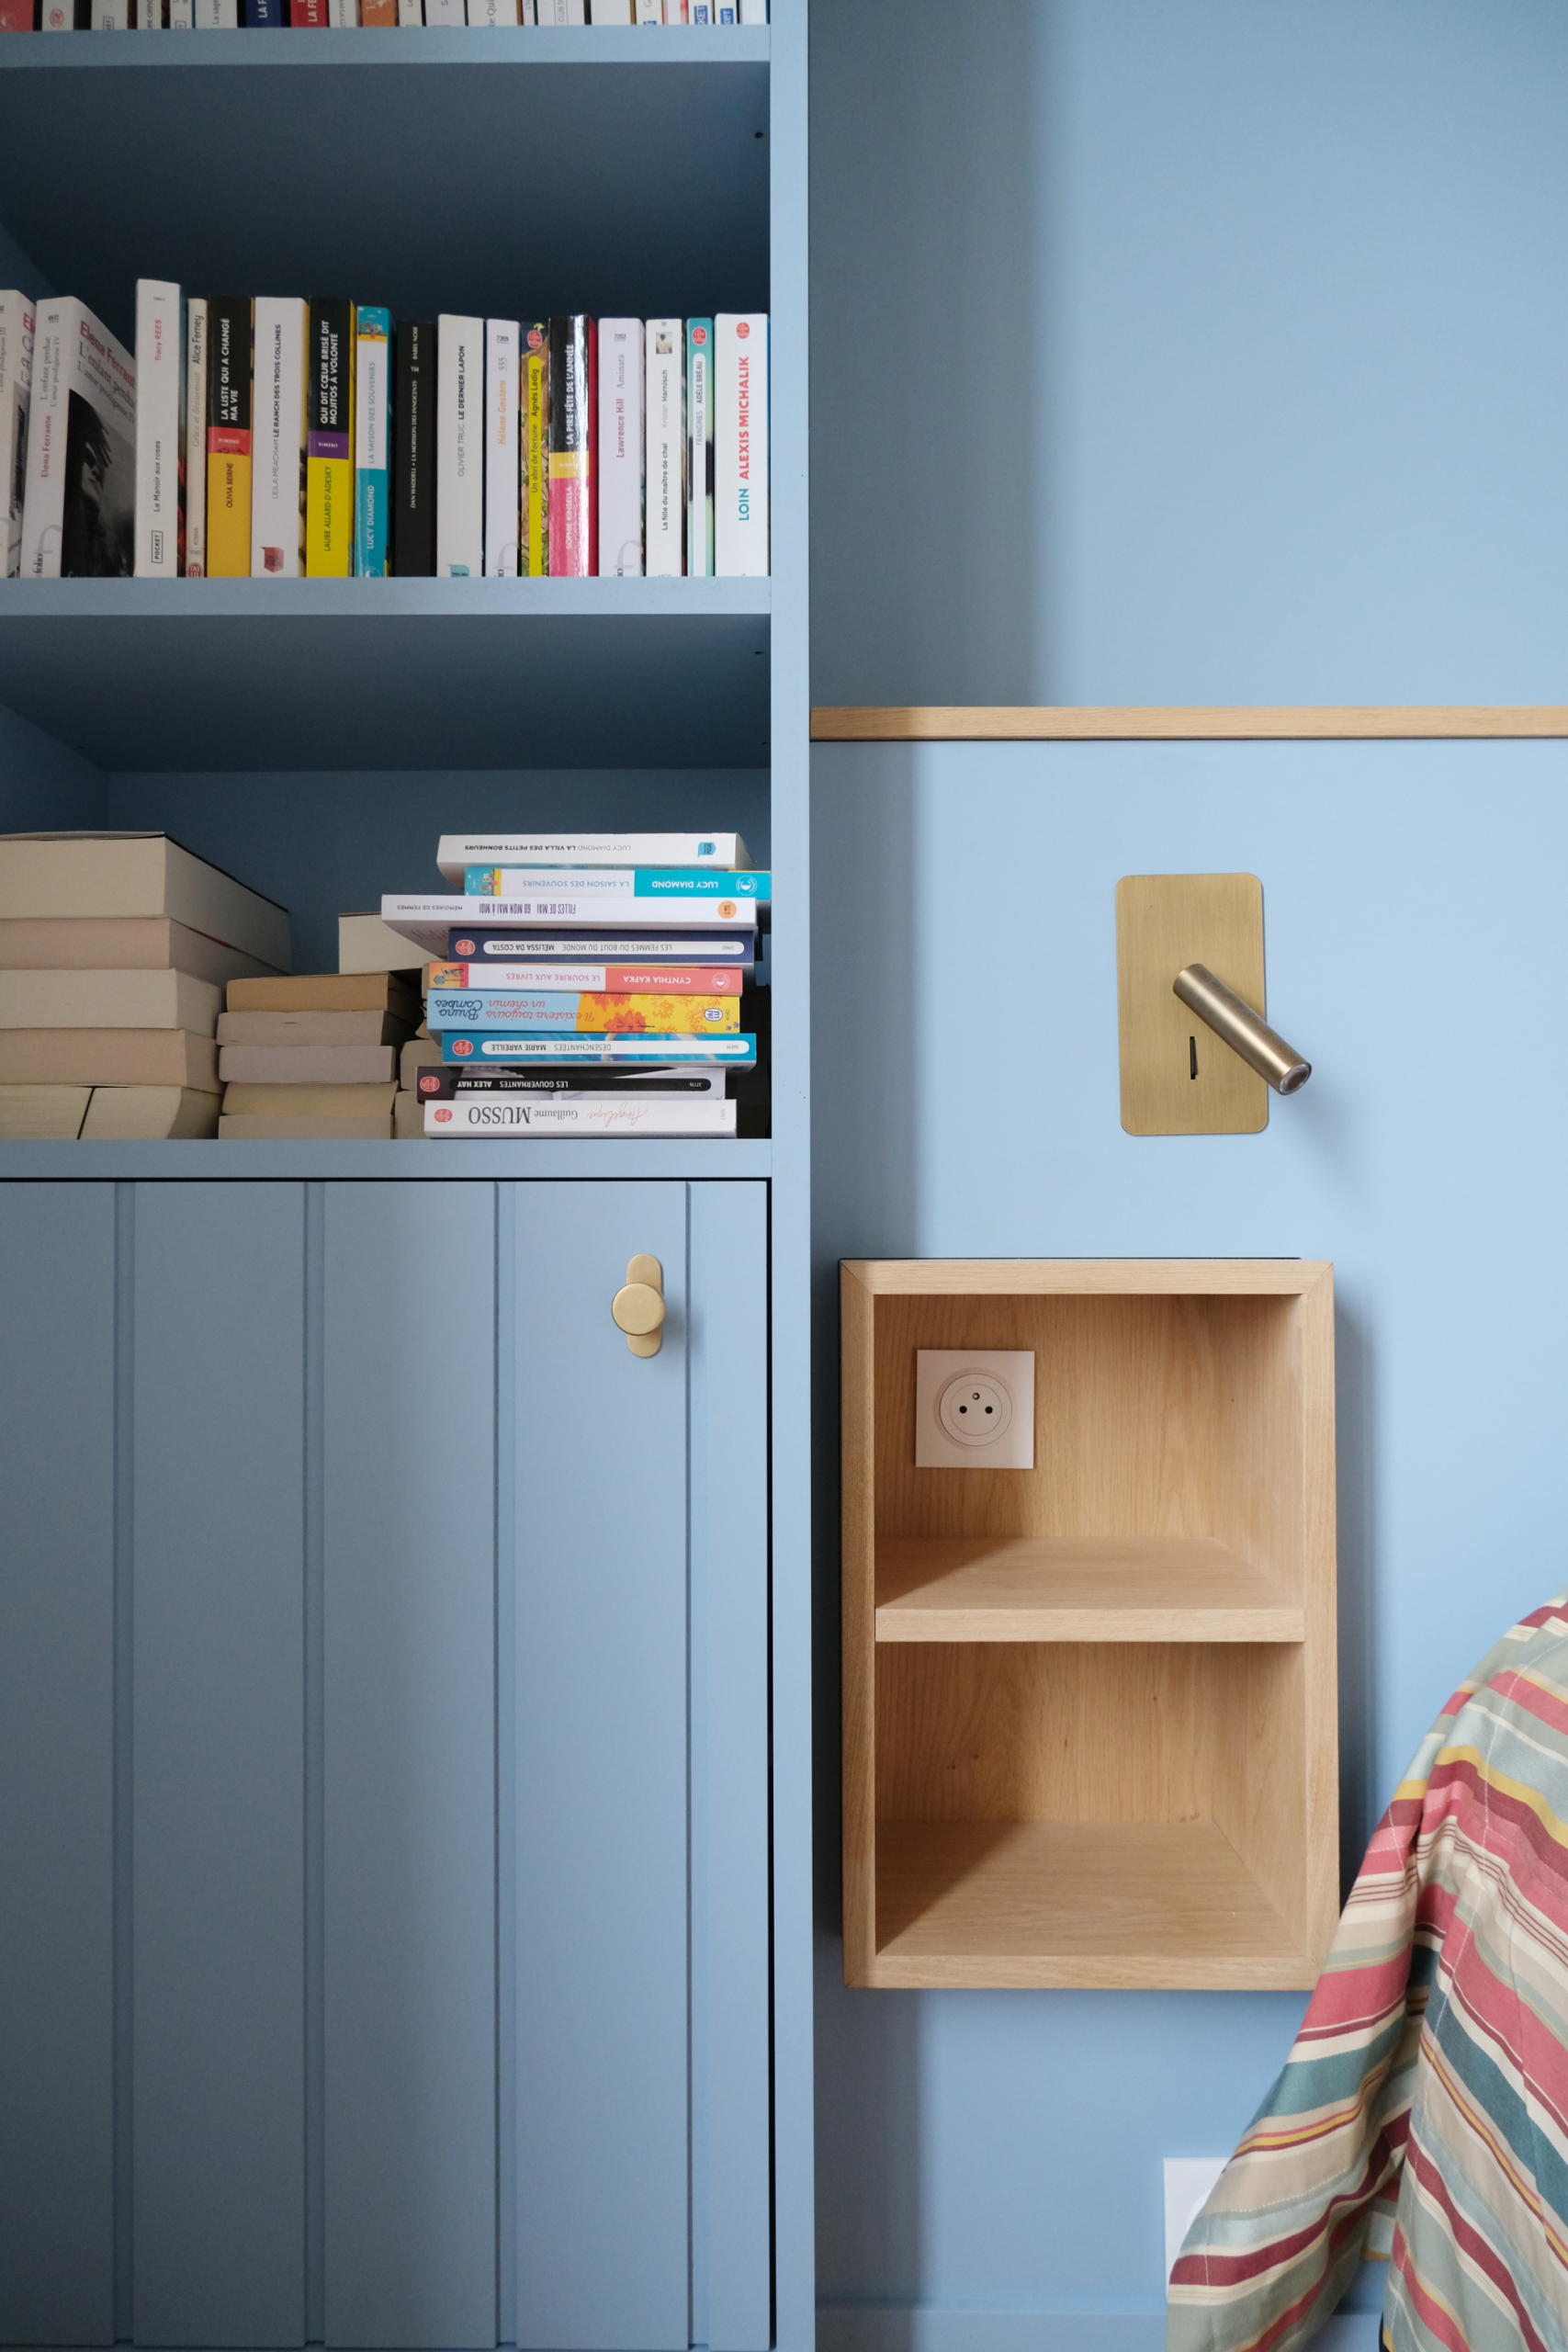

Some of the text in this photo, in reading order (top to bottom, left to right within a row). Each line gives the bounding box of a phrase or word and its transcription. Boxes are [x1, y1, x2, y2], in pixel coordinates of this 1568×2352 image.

[258, 6, 267, 17] LA
[309, 11, 318, 22] LA
[80, 320, 106, 356] Elena
[192, 315, 204, 364] Alice Ferney
[220, 318, 230, 356] CHANGÉ
[154, 342, 163, 361] Tracy
[319, 336, 329, 359] BRISÉ
[328, 333, 338, 374] VOLONTÉ
[39, 336, 51, 401] L'enfant perdue
[79, 341, 112, 385] L'enfant
[498, 356, 507, 371] 555
[321, 362, 329, 390] CŒUR
[615, 355, 625, 390] Aminata
[328, 376, 337, 384] À
[220, 386, 229, 406] LISTE
[321, 390, 329, 404] DIT
[531, 368, 540, 417] Agnès Ledig
[564, 344, 574, 445] LA PIRE FÊTE DE L'ANNÉE
[220, 409, 229, 420] LA
[231, 408, 238, 422] MA
[458, 410, 464, 420] LE
[498, 380, 506, 445] Hélène Gestern
[739, 356, 750, 481] ALEXIS MICHALIK
[274, 430, 279, 438] LE
[616, 399, 625, 458] Lawrence Hill
[41, 415, 51, 478] Elena Ferrante
[368, 456, 374, 464] LA
[412, 454, 416, 462] LA
[531, 457, 537, 465] de
[662, 459, 668, 469] de
[531, 482, 537, 493] Un
[662, 495, 668, 505] du
[739, 488, 750, 521] LOIN
[662, 522, 668, 531] La
[32, 553, 43, 573] folio
[479, 903, 531, 914] 68 MON MAI MOI
[536, 903, 576, 914] FILLES DE MAI
[527, 944, 554, 952] MÉLISSA
[434, 1000, 482, 1011] Combes
[488, 1000, 528, 1010] chemin
[439, 1008, 479, 1020] Bruno
[485, 1008, 581, 1021] existera toujours
[468, 1106, 531, 1125] MUSSO
[534, 1110, 578, 1120] Guillaume
[587, 1102, 648, 1128] Angélique
